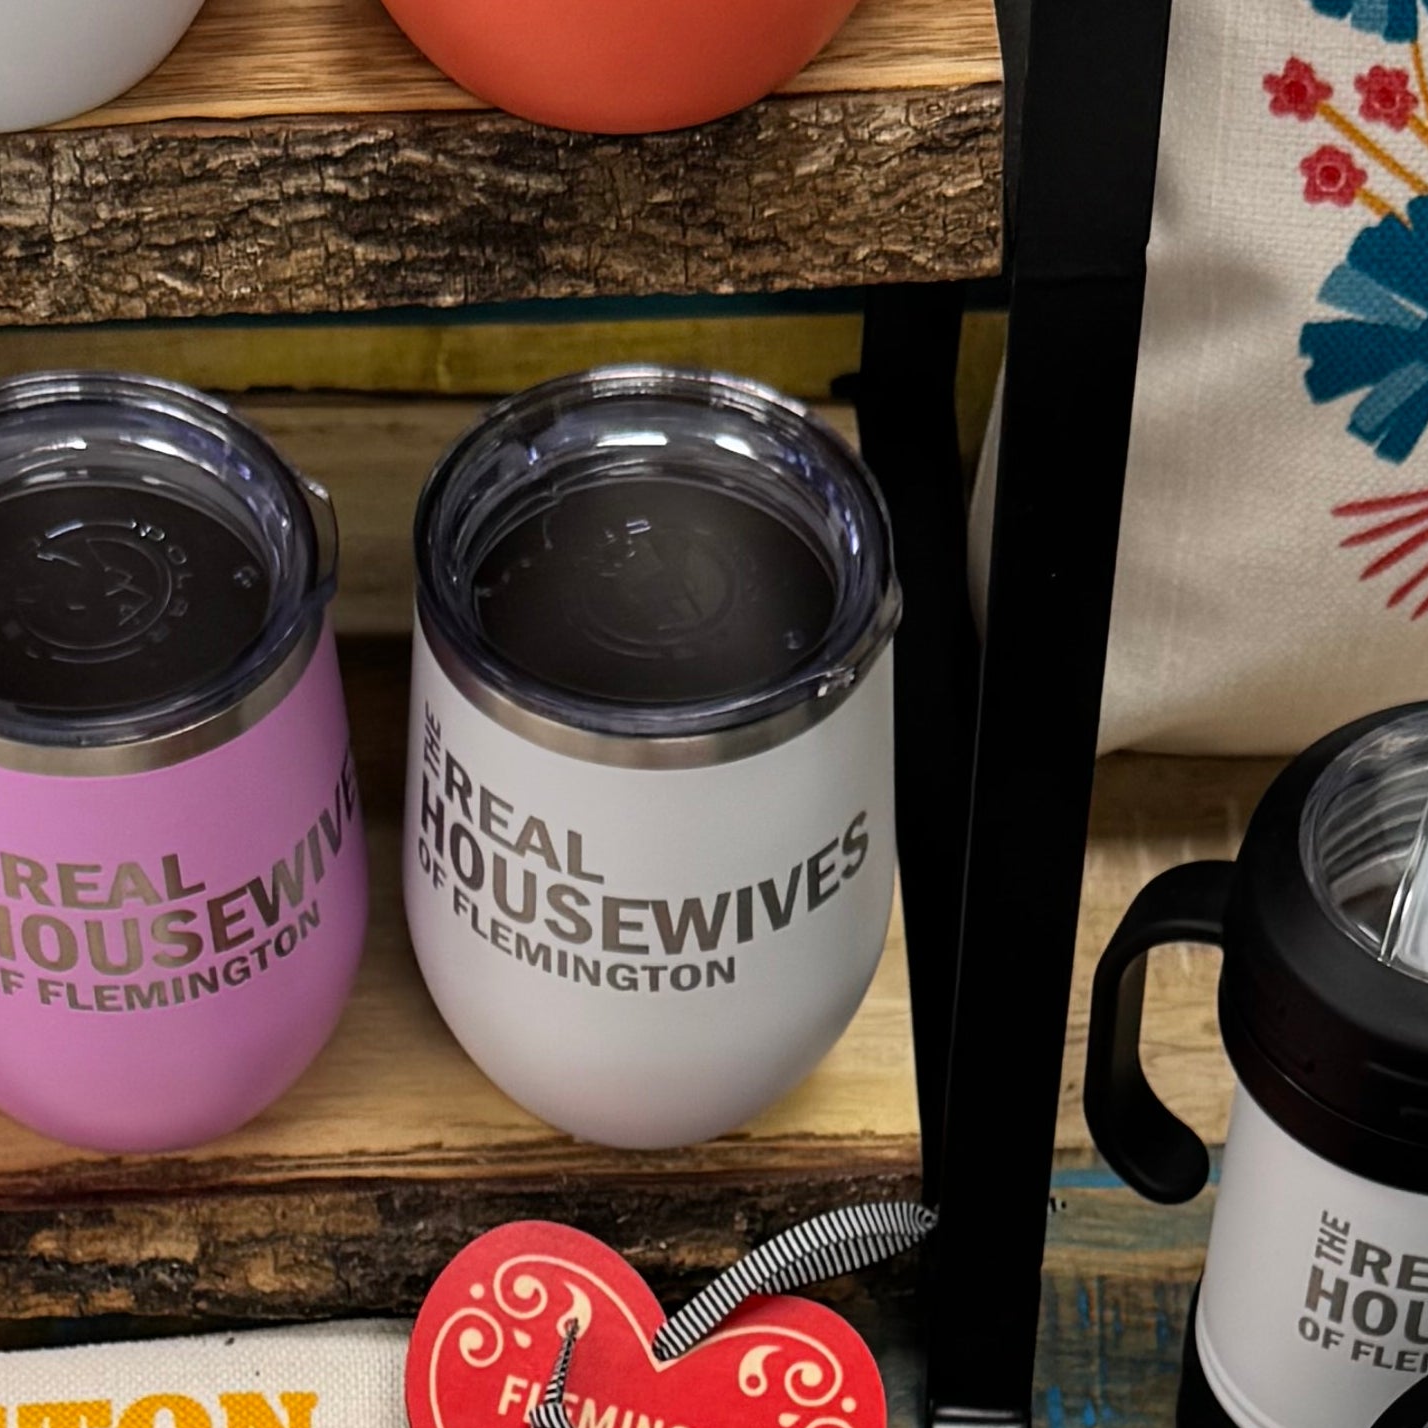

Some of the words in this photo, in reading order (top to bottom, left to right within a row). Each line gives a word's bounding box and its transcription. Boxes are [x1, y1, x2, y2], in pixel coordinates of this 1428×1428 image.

[423, 699, 443, 782] THE
[419, 772, 870, 956] HOUSEWIVES
[444, 749, 605, 886] REAL
[0, 852, 206, 911] REAL
[417, 836, 448, 891] OF
[452, 886, 737, 993] FLEMINGTON
[36, 900, 322, 1014] FLEMINGTON
[1316, 1209, 1351, 1267] THE
[1297, 1315, 1345, 1351] OF
